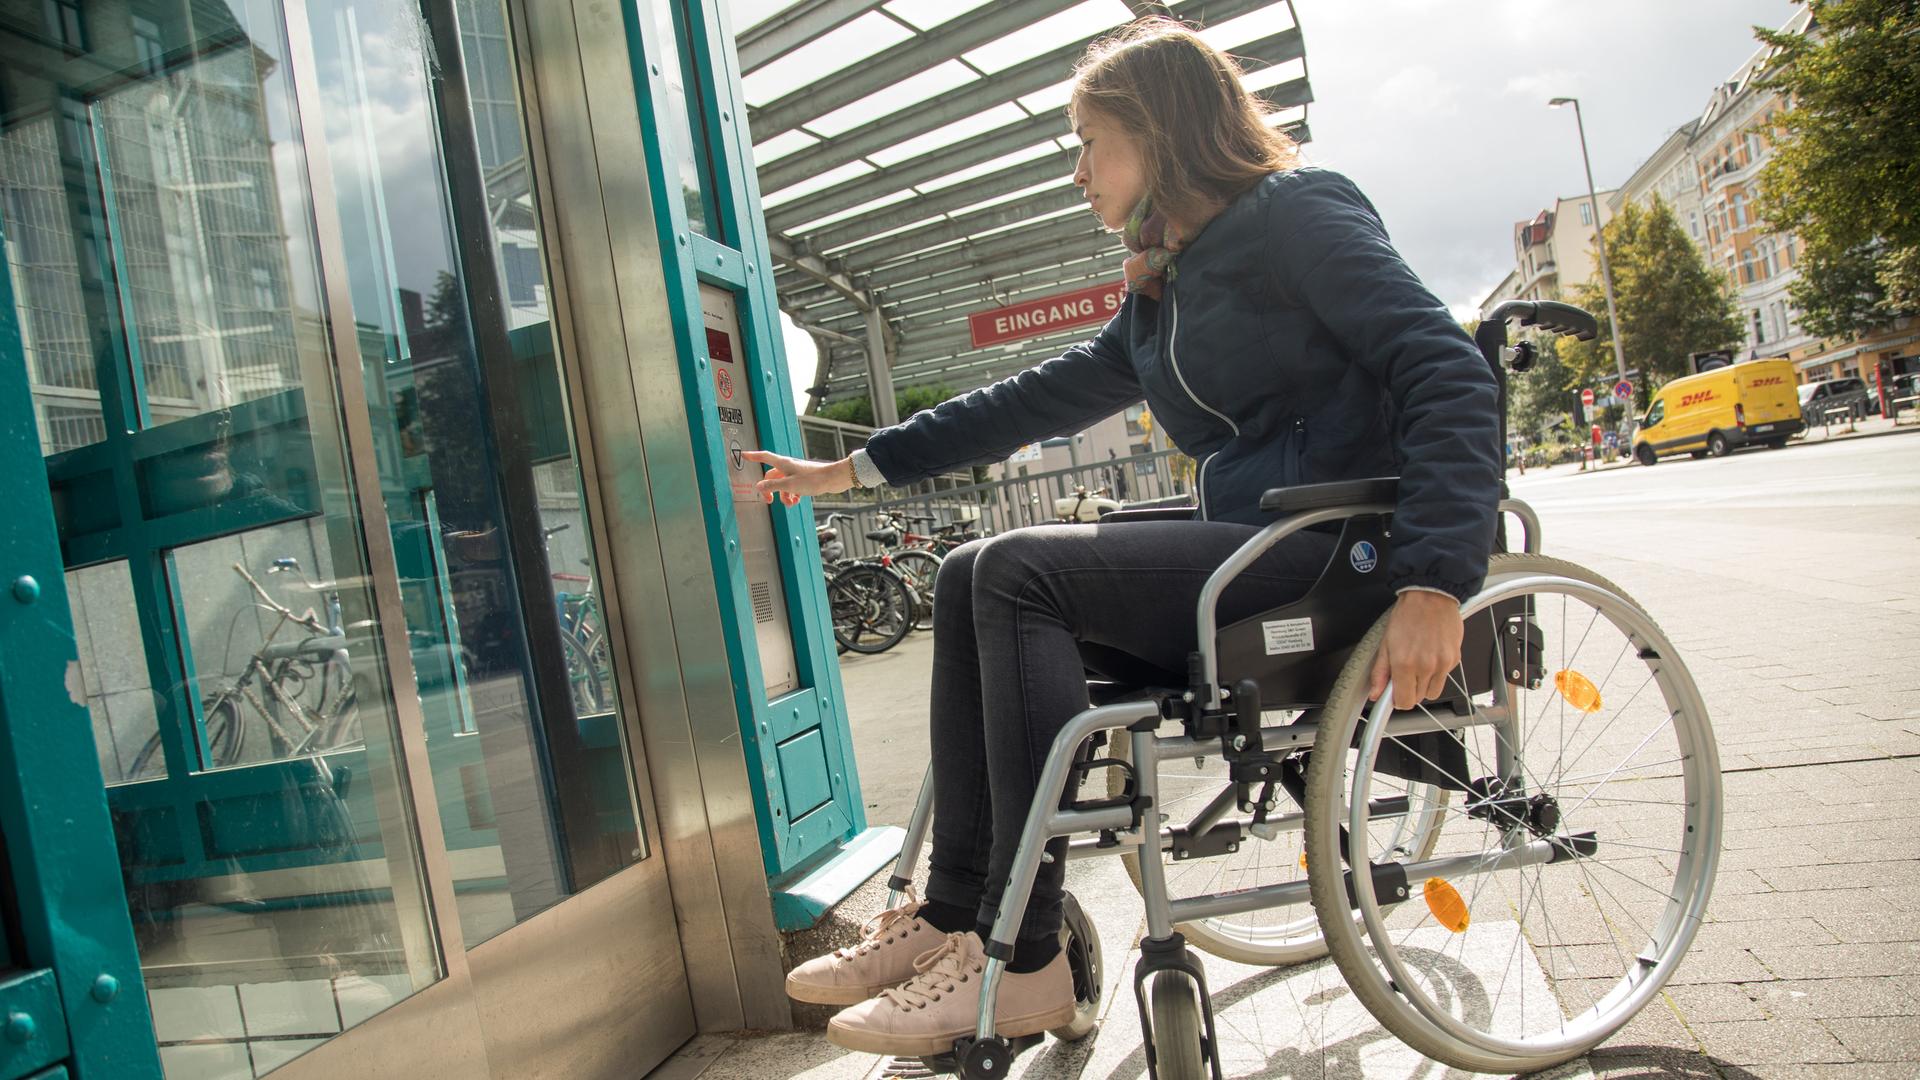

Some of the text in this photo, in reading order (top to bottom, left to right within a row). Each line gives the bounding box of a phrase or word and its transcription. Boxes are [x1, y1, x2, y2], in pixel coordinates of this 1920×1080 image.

[995, 298, 1094, 334] EINGANG
[1752, 377, 1784, 387] DHL
[1681, 389, 1714, 407] DHL
